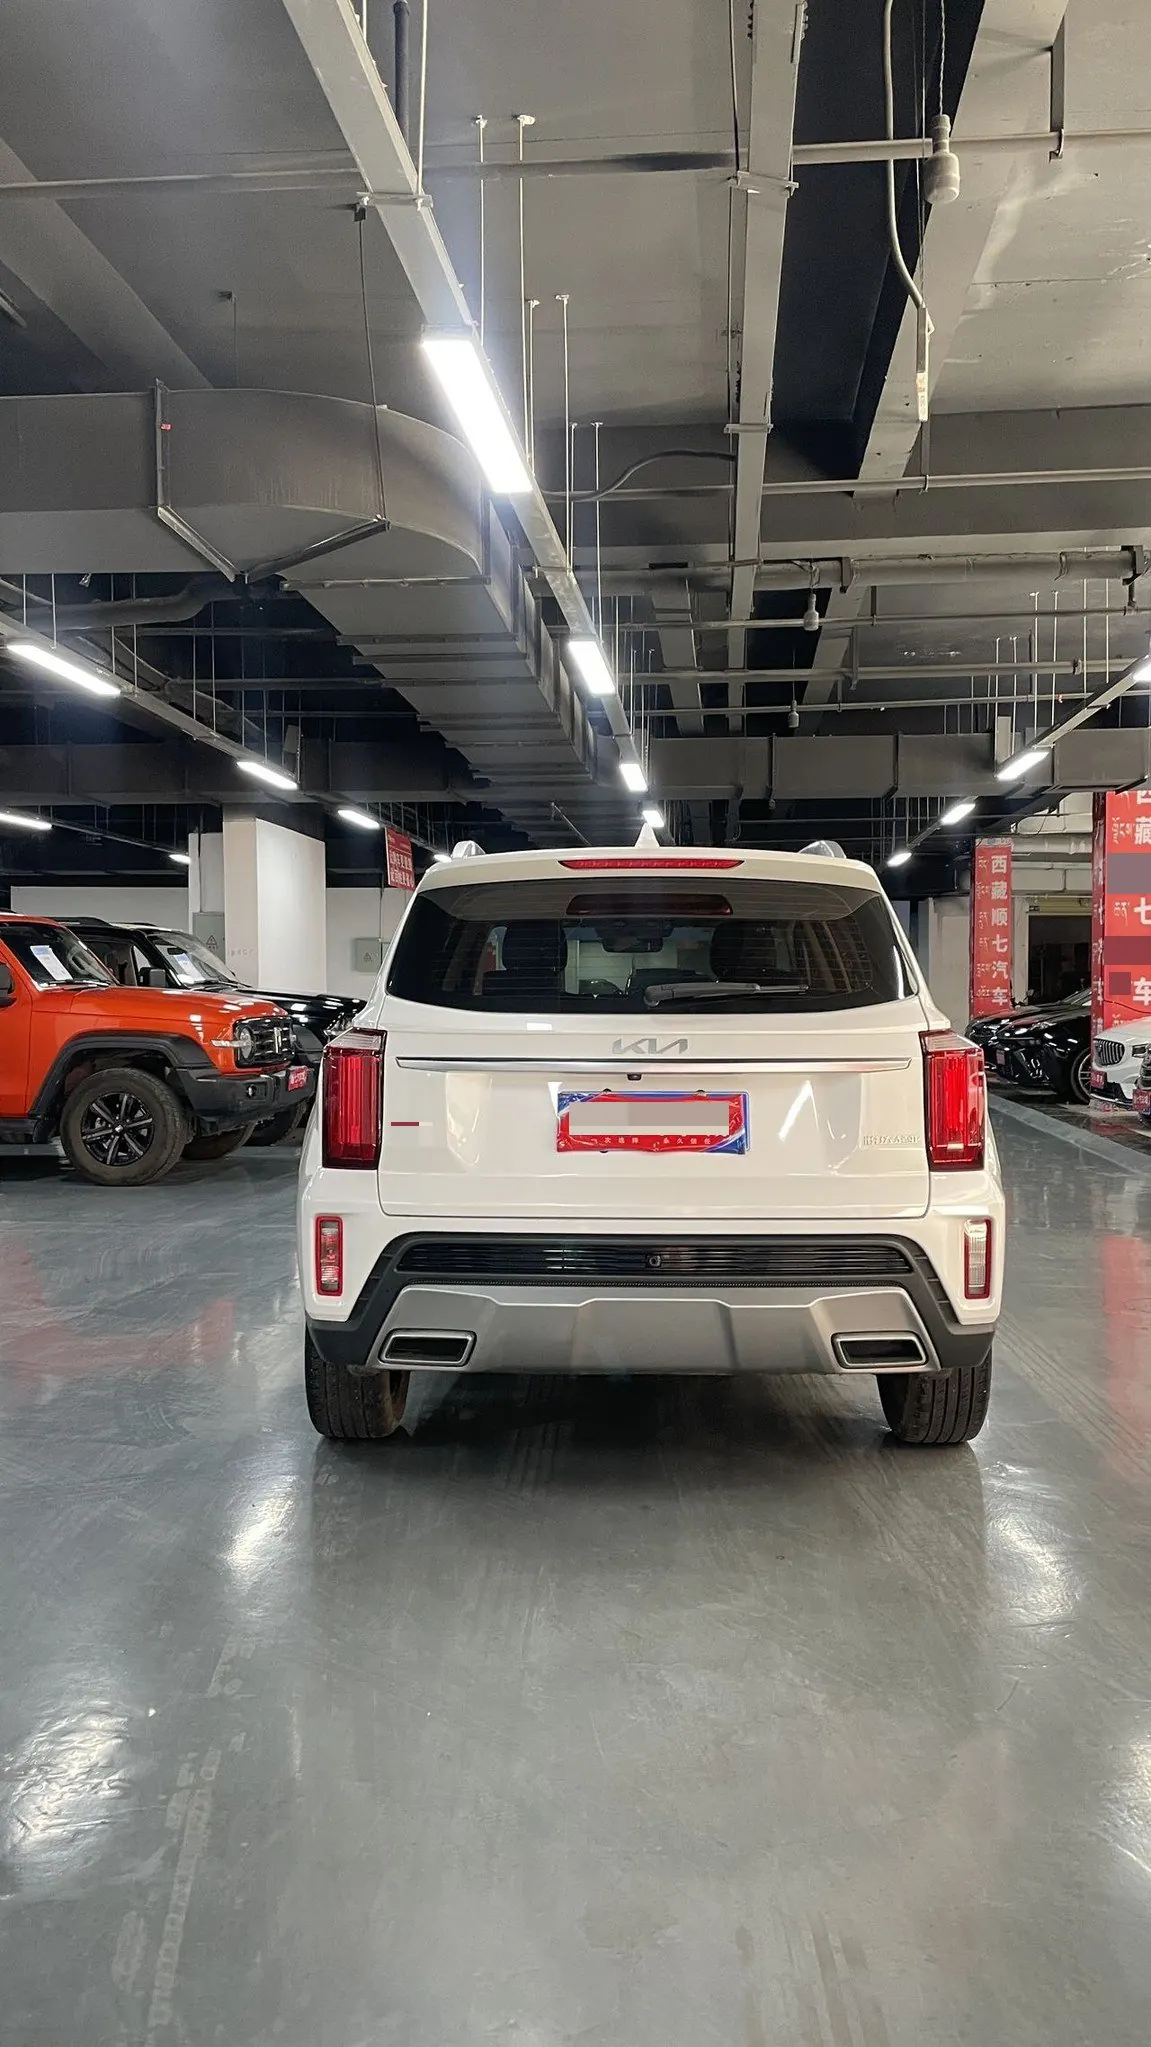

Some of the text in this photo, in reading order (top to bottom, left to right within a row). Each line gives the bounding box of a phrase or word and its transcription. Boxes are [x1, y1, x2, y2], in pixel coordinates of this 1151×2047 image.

[991, 855, 1008, 1006] 西藏顺七汽车
[611, 1038, 688, 1054] KIA
